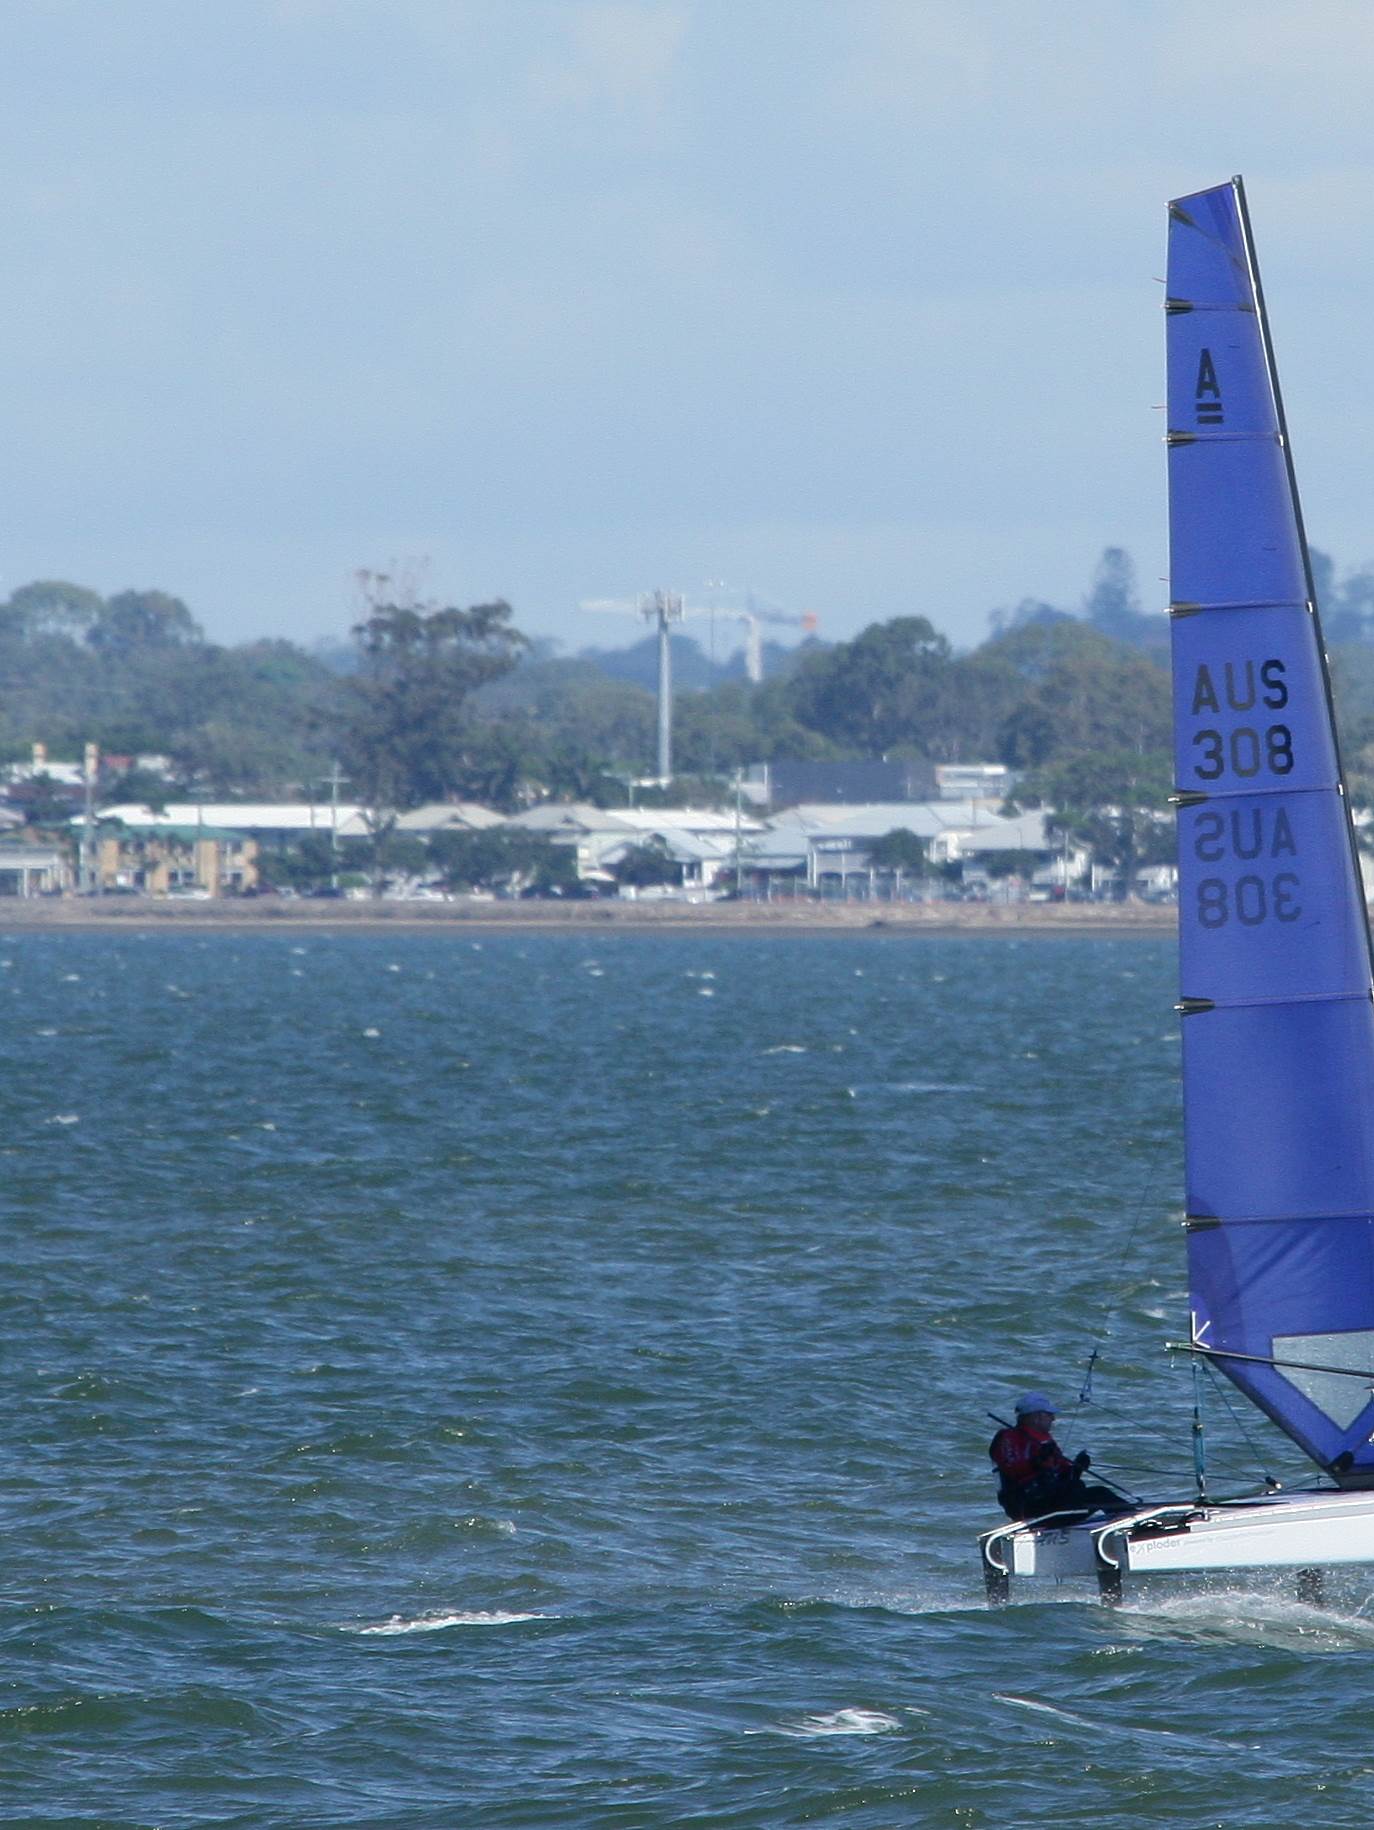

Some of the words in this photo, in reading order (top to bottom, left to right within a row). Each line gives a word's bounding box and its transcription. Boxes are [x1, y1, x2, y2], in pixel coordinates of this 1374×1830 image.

[1196, 347, 1221, 399] A
[1191, 659, 1288, 715] AUS
[1192, 724, 1295, 780] 308
